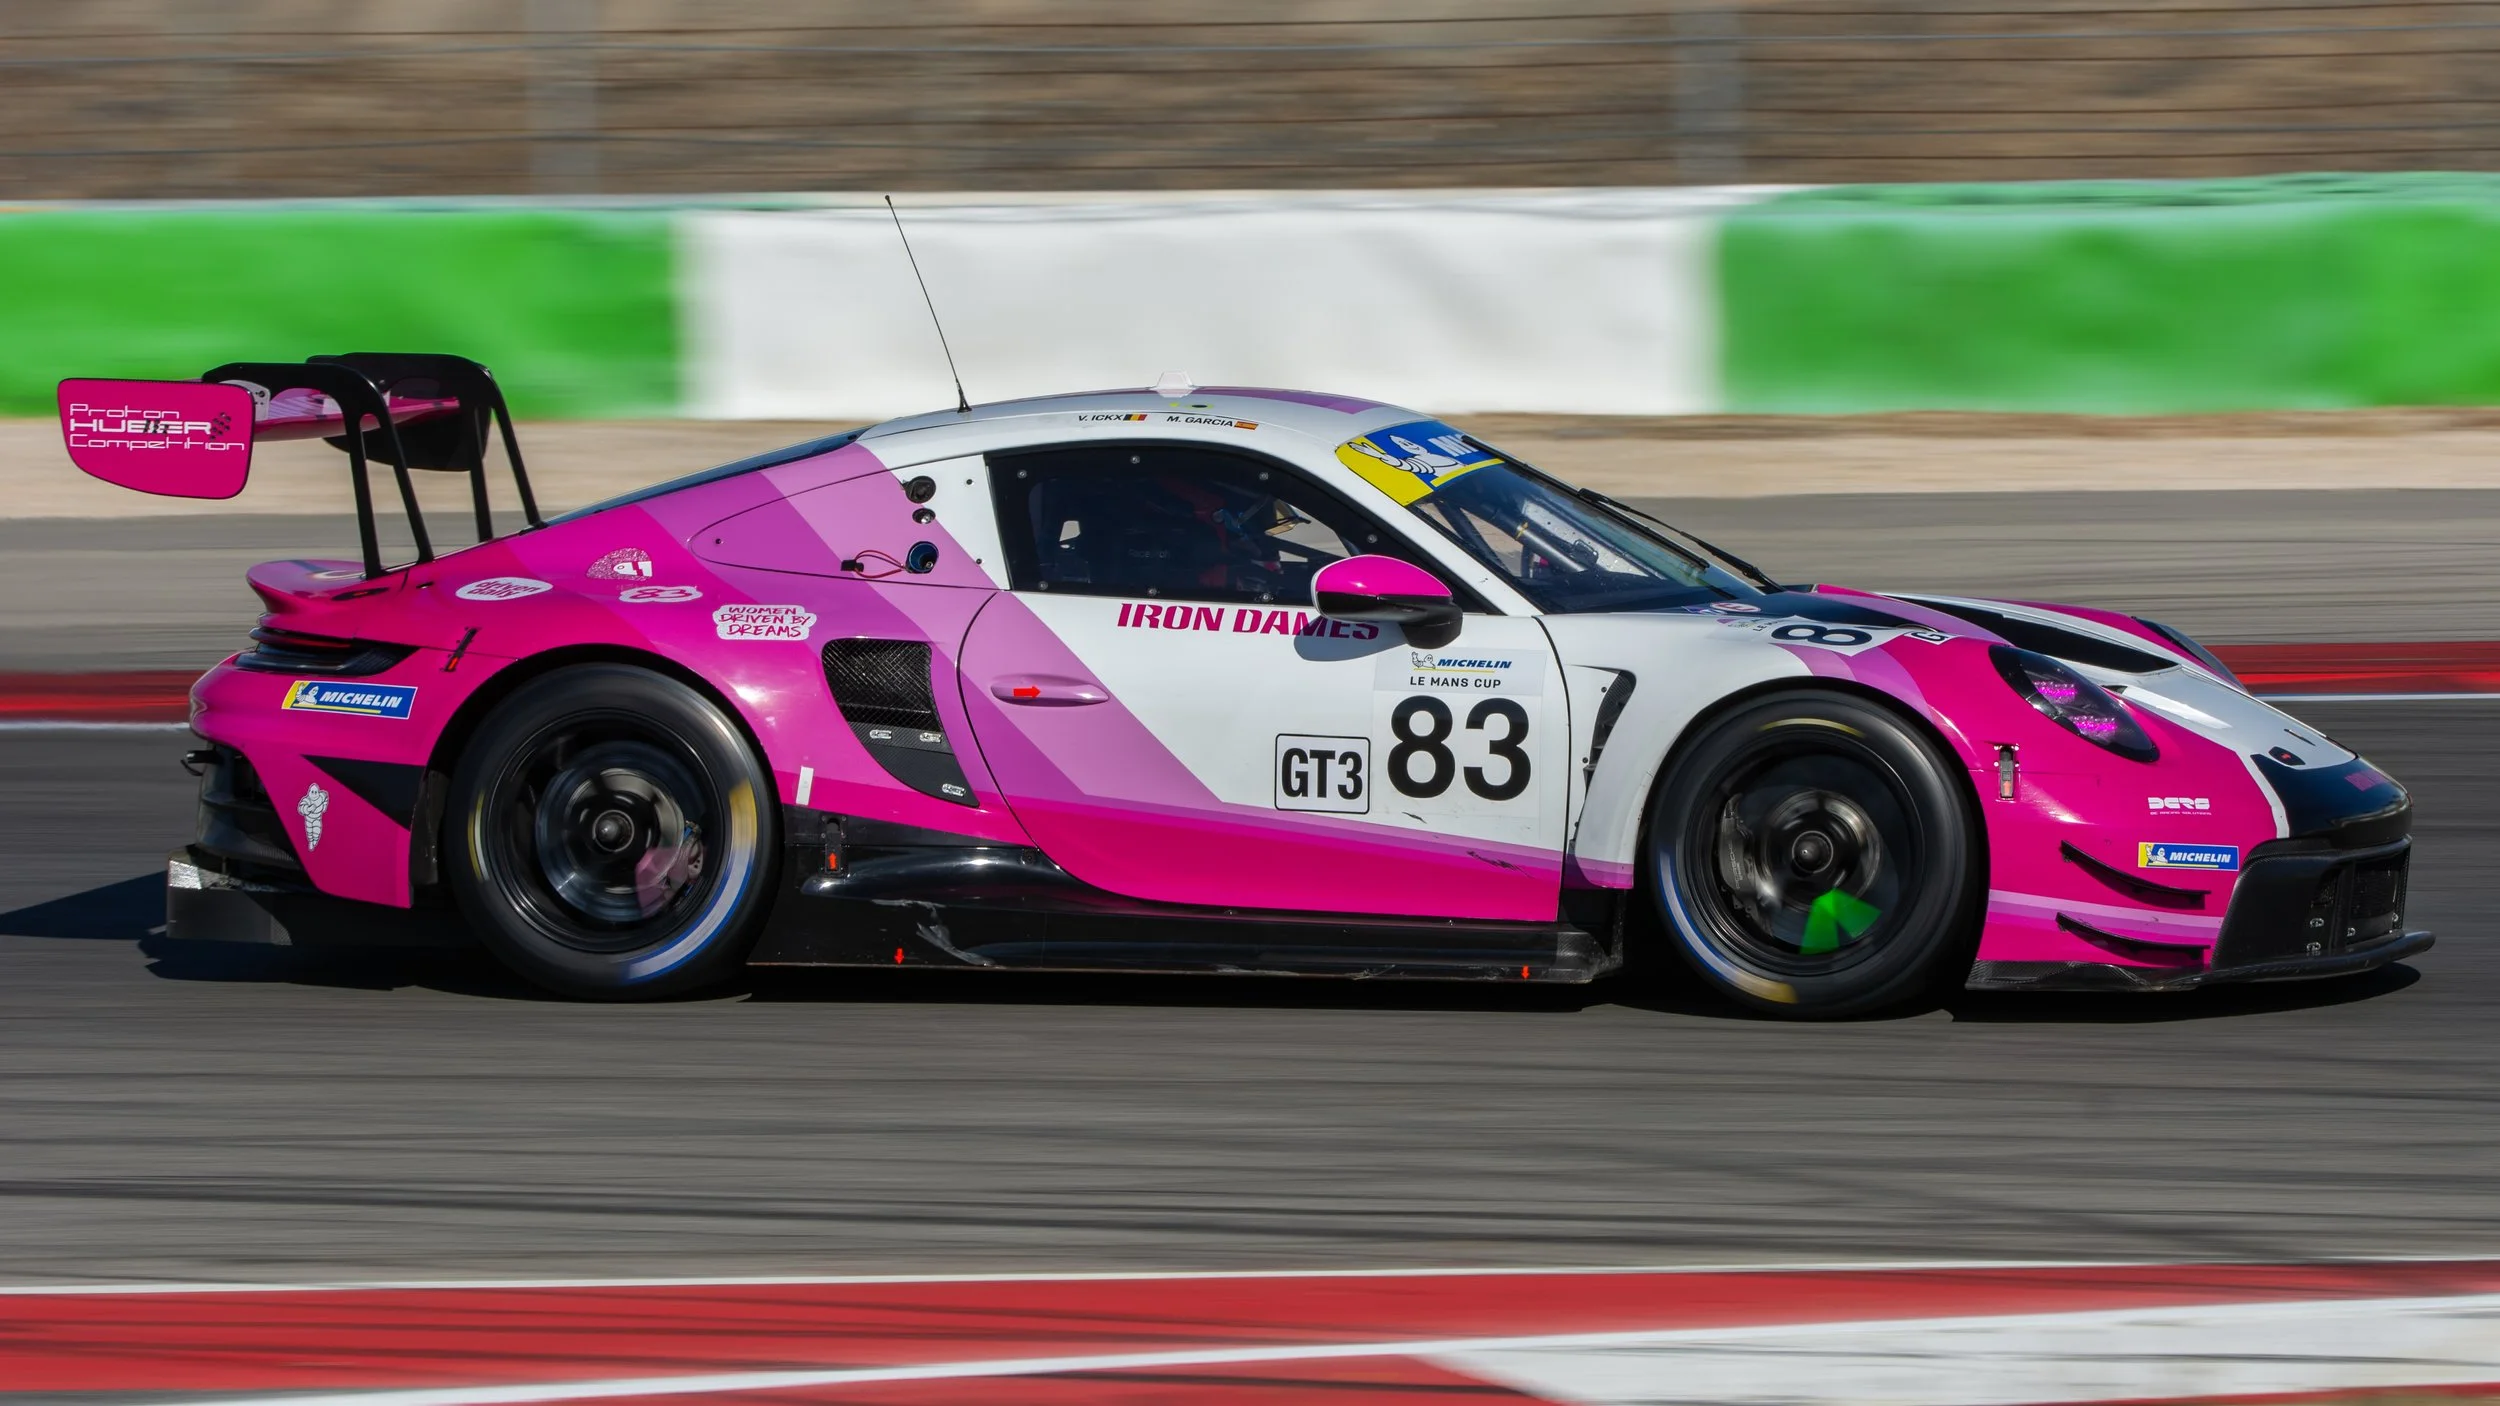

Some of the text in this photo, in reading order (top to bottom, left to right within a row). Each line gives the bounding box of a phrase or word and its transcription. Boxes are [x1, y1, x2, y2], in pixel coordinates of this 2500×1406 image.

[70, 403, 180, 419] Proton
[1078, 414, 1125, 422] V. ICKX
[1166, 415, 1233, 427] M. GARCIA
[70, 433, 245, 451] Competition
[728, 606, 797, 615] WOMEN
[719, 613, 811, 626] DRIVEN BY
[1117, 602, 1380, 641] IRON DAMES
[726, 623, 802, 638] DREAMS
[1437, 658, 1512, 669] MICHELIN
[1410, 676, 1502, 689] LE MANS CUP
[319, 690, 403, 709] MICHELIN
[1387, 695, 1532, 801] 83
[1281, 748, 1363, 800] GT3
[2169, 851, 2231, 864] MICHELIN
